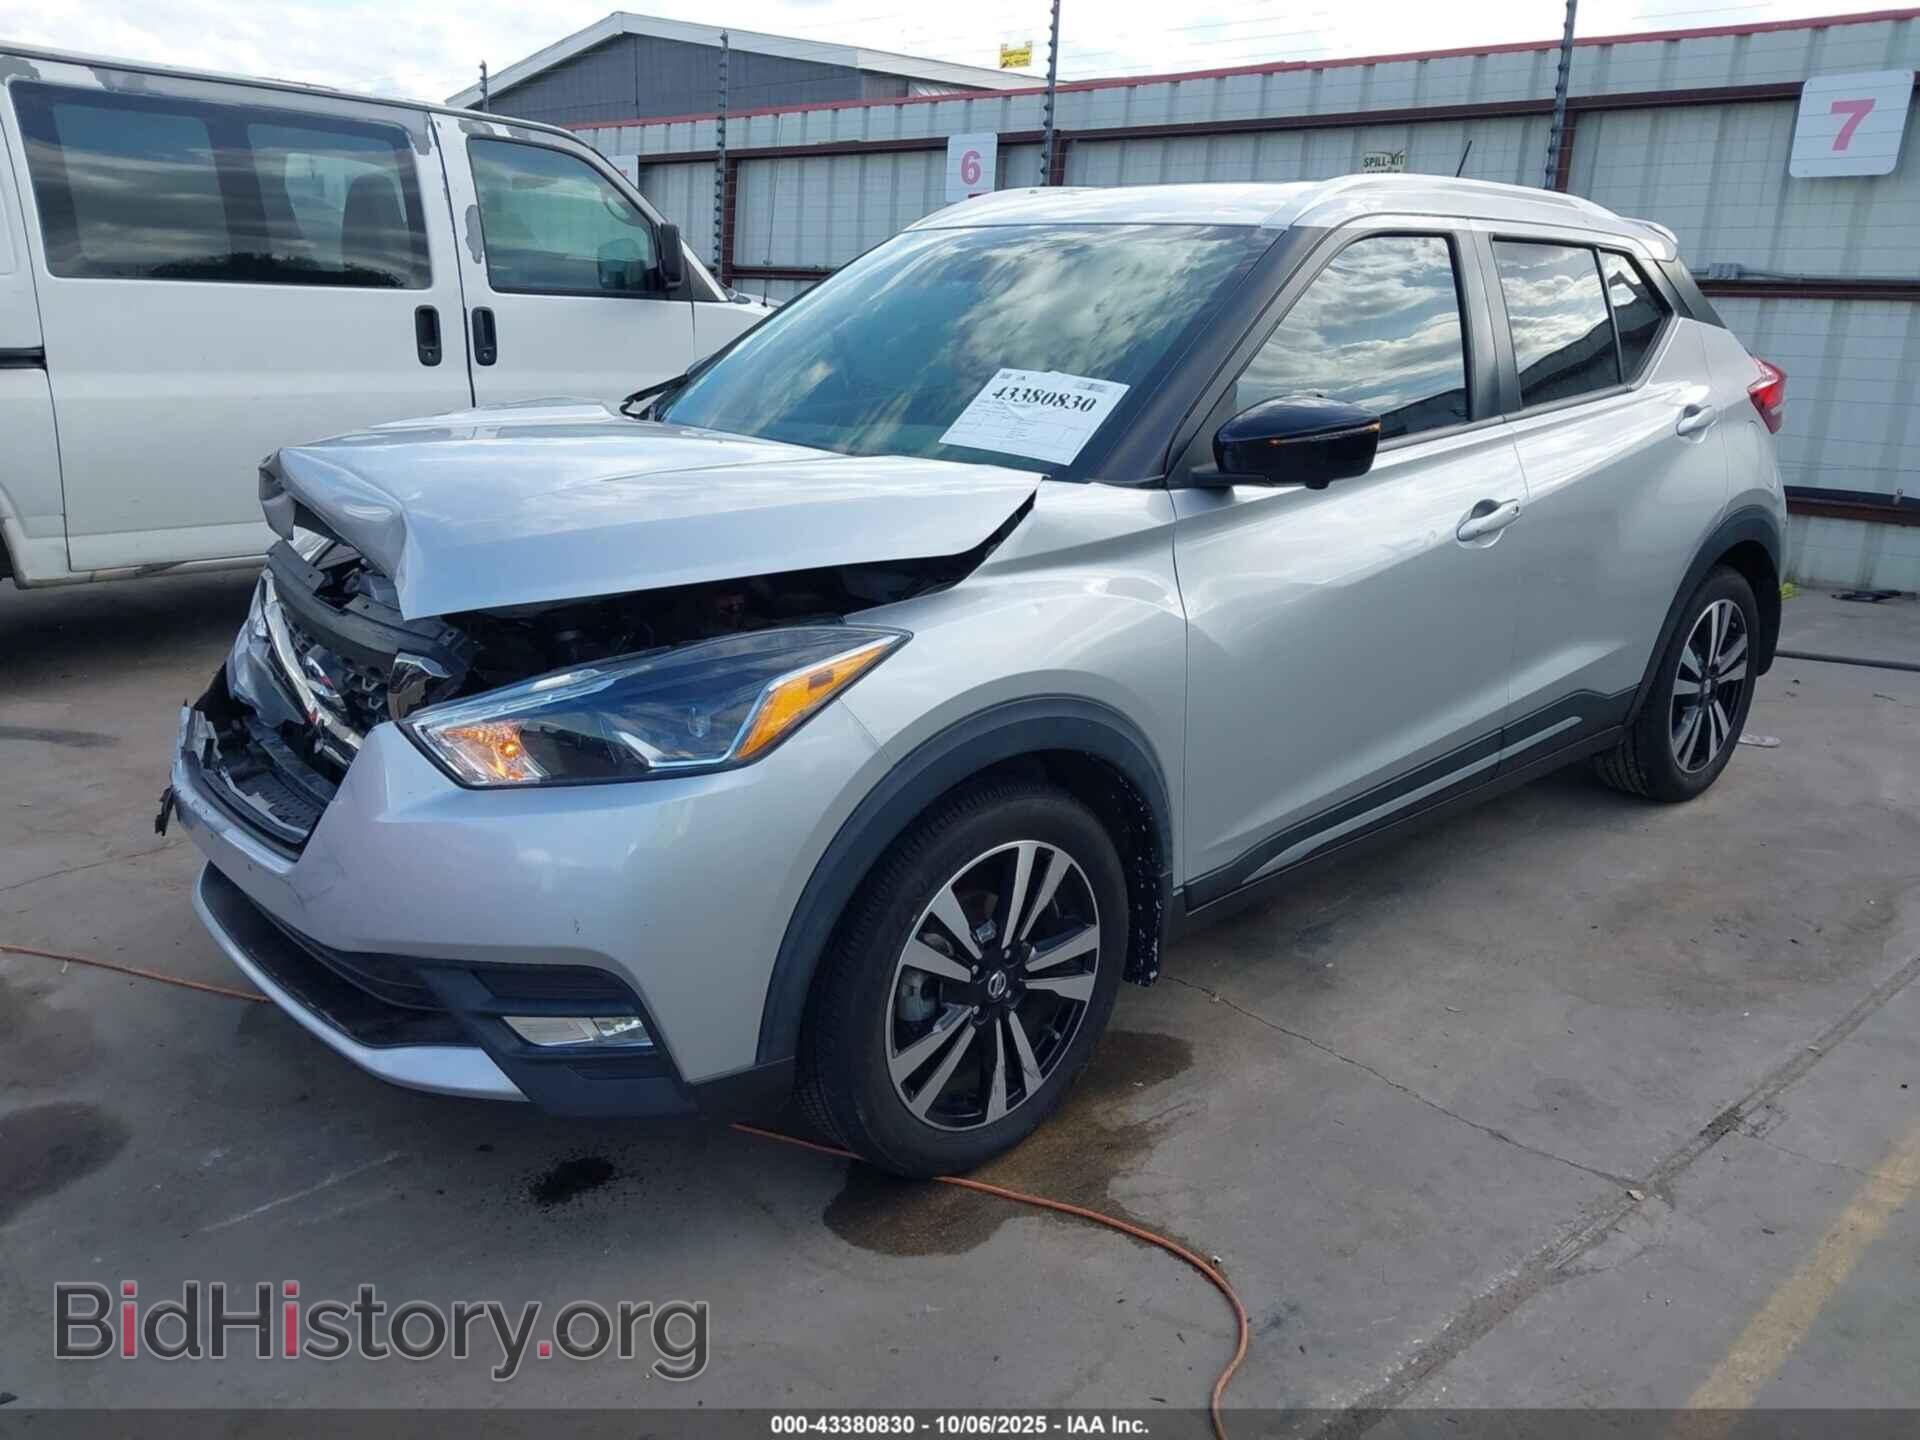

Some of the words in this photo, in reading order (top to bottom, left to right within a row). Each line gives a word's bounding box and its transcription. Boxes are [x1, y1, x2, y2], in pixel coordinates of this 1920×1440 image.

[1830, 98, 1876, 152] 7
[961, 150, 981, 185] 6
[992, 386, 1097, 412] 43380830
